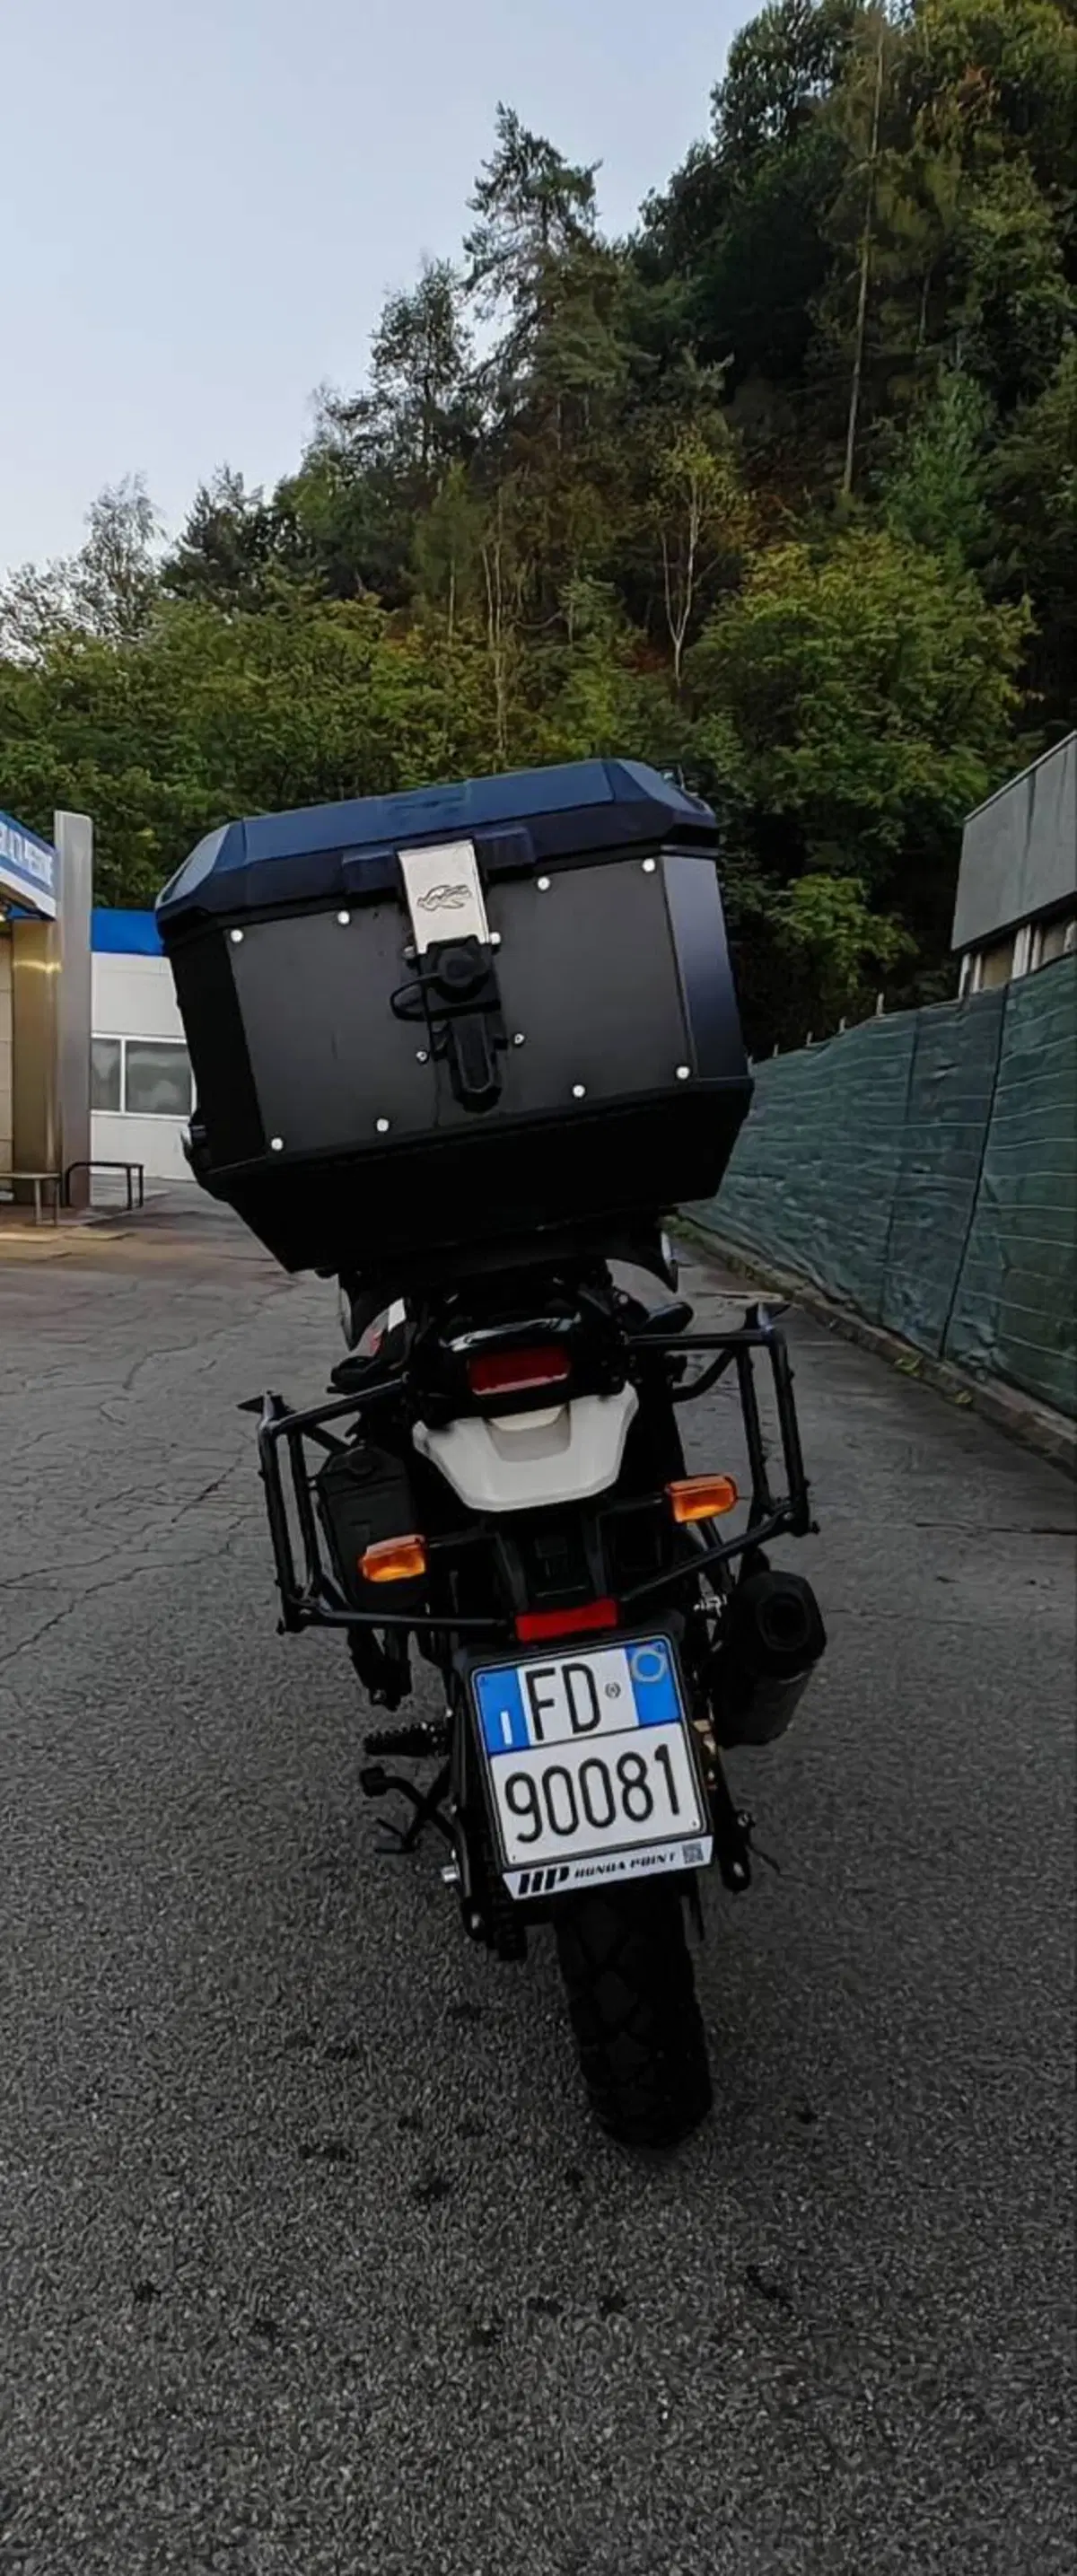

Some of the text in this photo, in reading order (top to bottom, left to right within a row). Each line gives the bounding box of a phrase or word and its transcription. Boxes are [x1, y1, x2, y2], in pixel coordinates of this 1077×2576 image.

[525, 1662, 601, 1741] FD
[504, 1743, 679, 1843] 90081
[574, 1861, 626, 1879] HONDA
[630, 1852, 676, 1869] POINT
